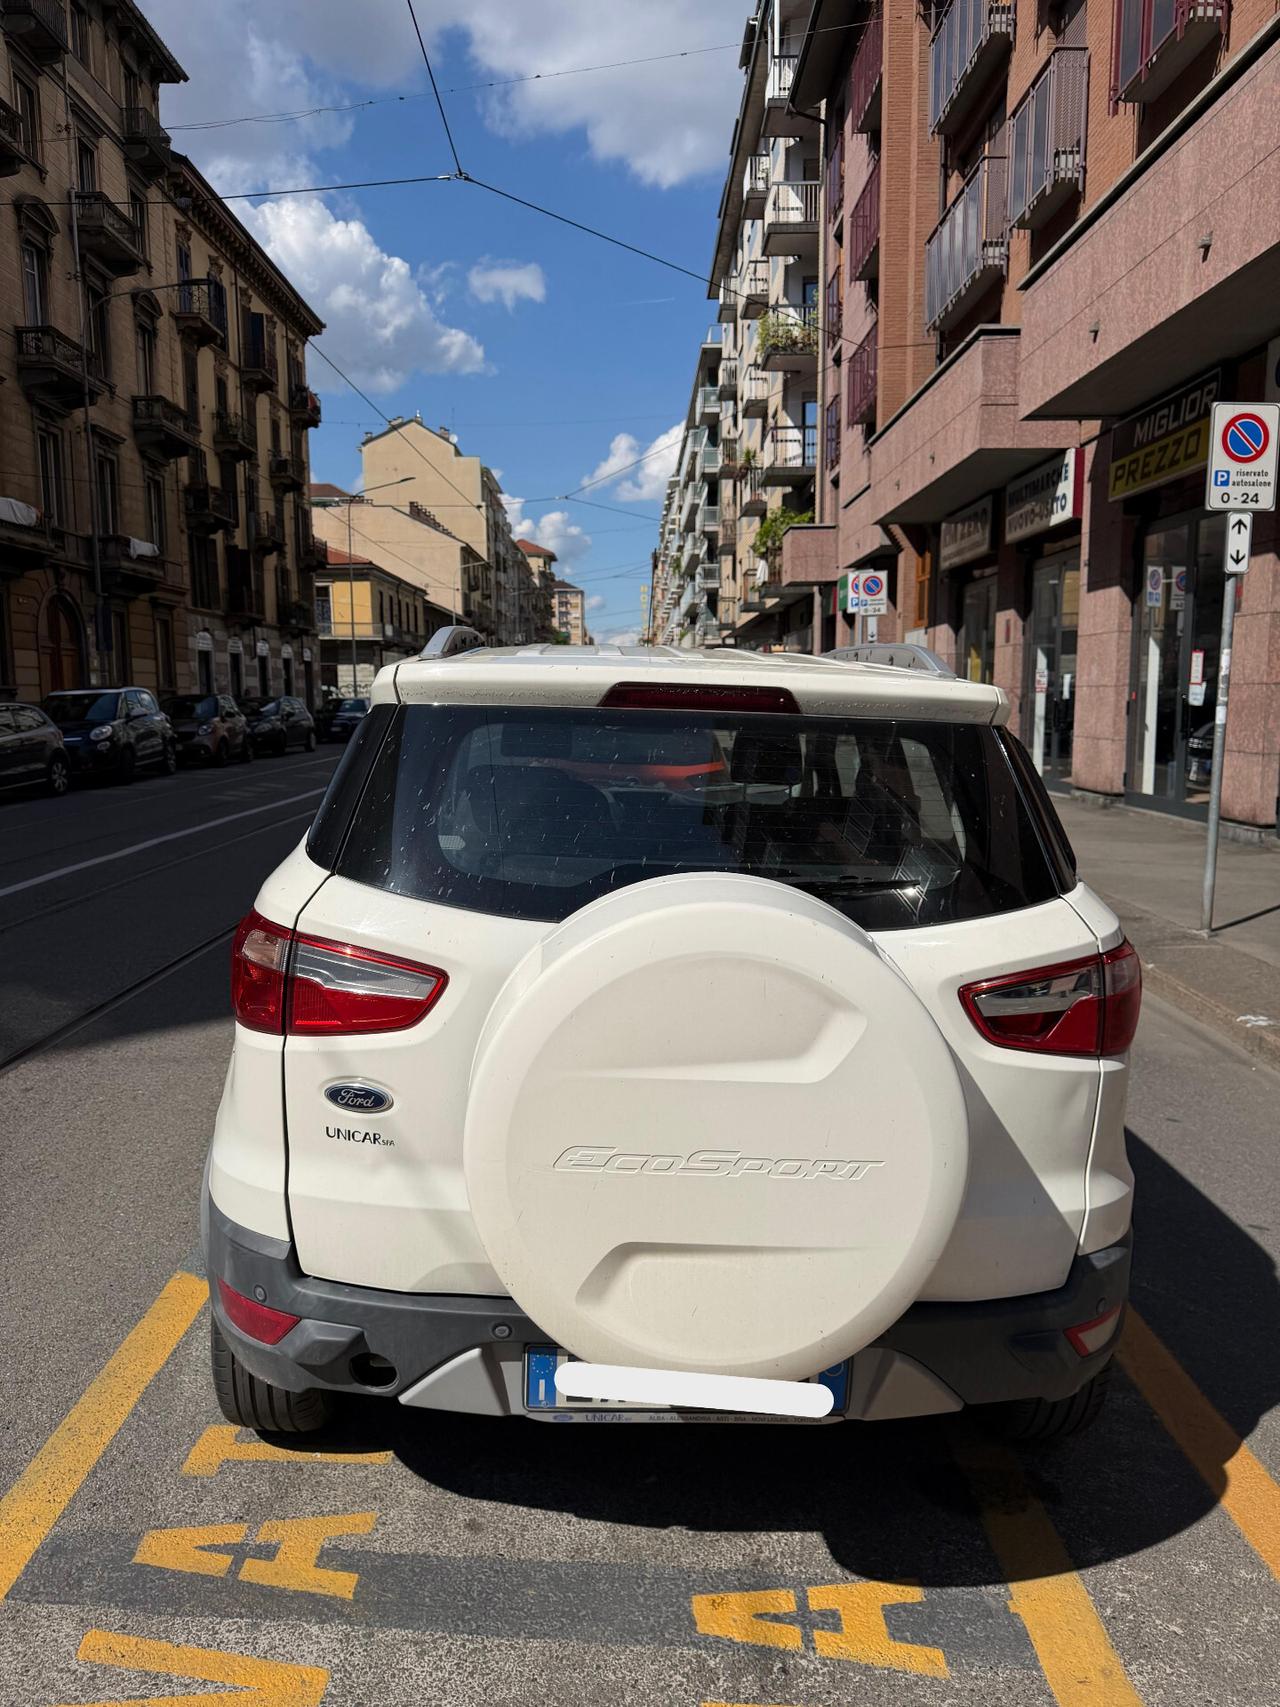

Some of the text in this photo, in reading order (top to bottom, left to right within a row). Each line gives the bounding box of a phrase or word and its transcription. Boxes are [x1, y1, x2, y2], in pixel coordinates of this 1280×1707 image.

[1133, 382, 1218, 447] MIGLIOR
[1112, 427, 1202, 491] PREZZO
[1217, 472, 1227, 485] P
[1236, 469, 1269, 478] riservato
[1231, 479, 1272, 488] autosalone
[337, 1088, 375, 1107] Ford
[325, 1126, 382, 1145] UNICAR
[584, 1413, 625, 1422] UNICAR
